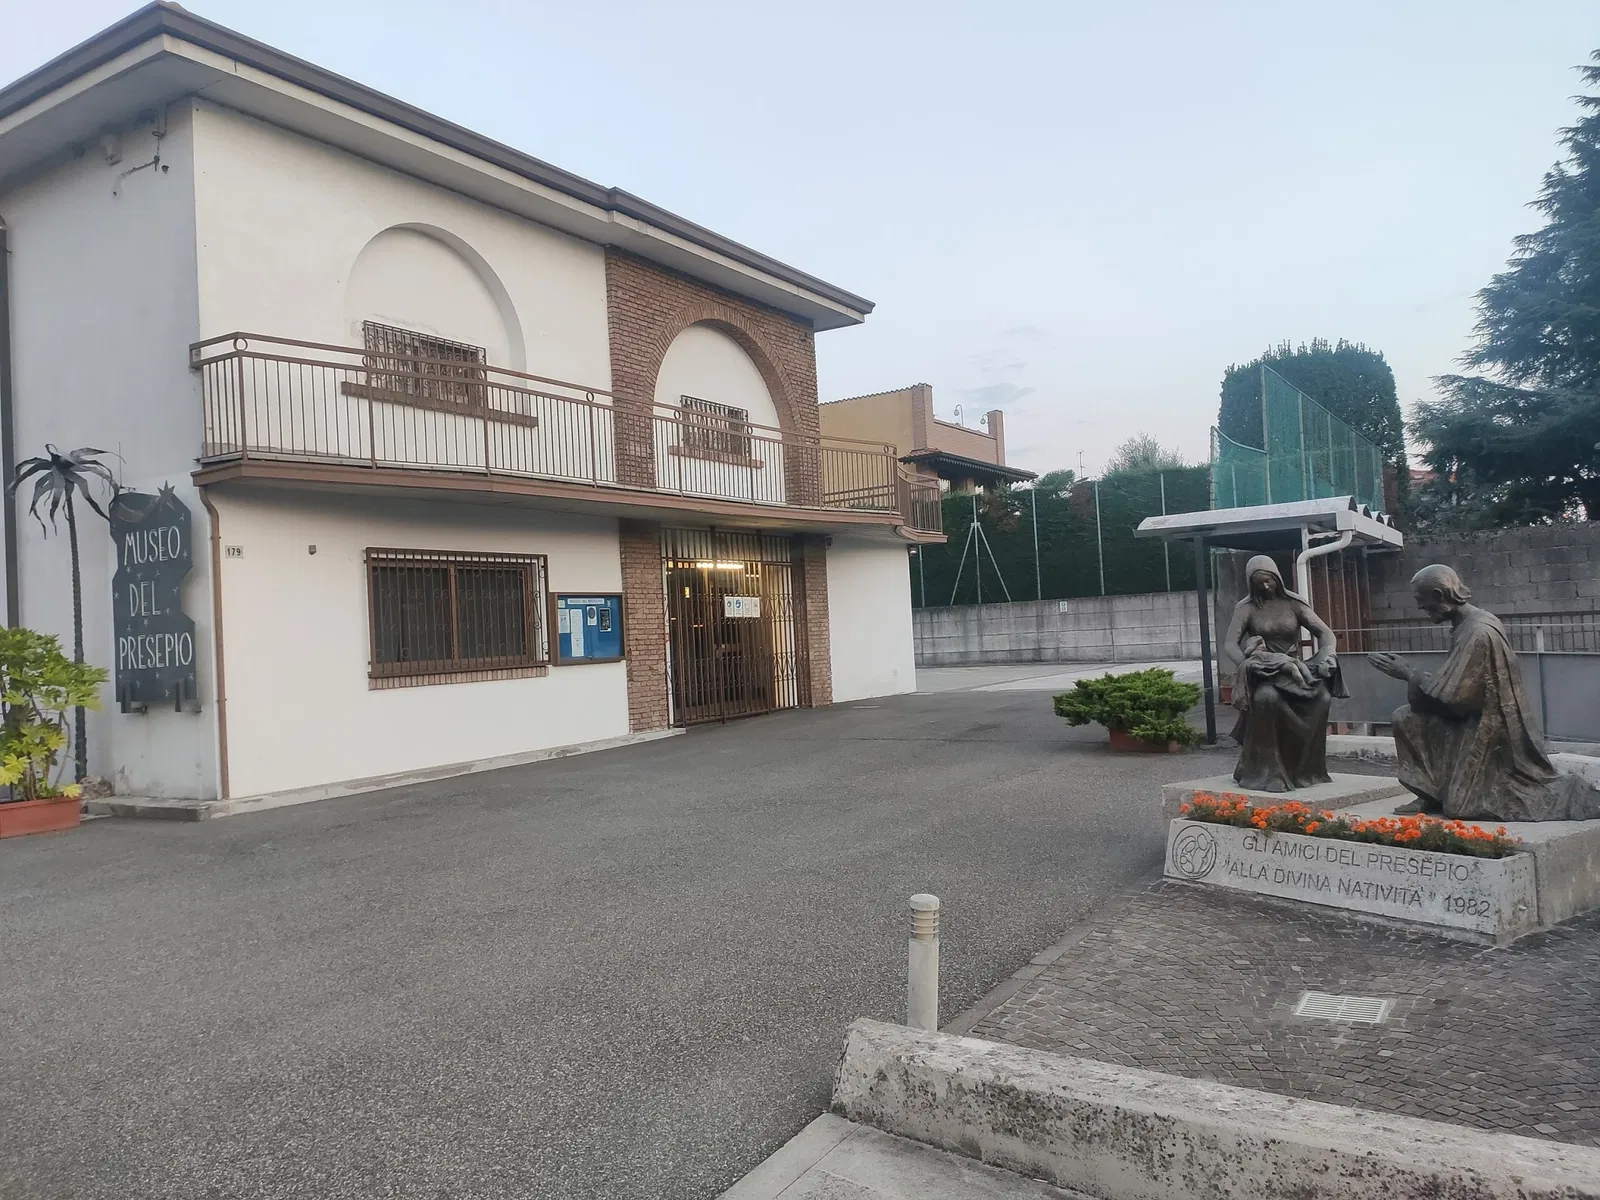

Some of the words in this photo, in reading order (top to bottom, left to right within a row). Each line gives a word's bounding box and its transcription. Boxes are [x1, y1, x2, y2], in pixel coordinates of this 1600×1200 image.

[124, 526, 181, 565] MUSEO
[227, 547, 241, 557] 179
[129, 581, 161, 617] DEL
[119, 632, 193, 670] PRESEPIO
[1242, 835, 1267, 853] GLI
[1272, 840, 1319, 861] AMICI
[1326, 847, 1361, 867] DEL
[1367, 852, 1469, 881] PRESEPIO
[1274, 868, 1331, 892] DIVINA
[1443, 894, 1491, 918] 1982
